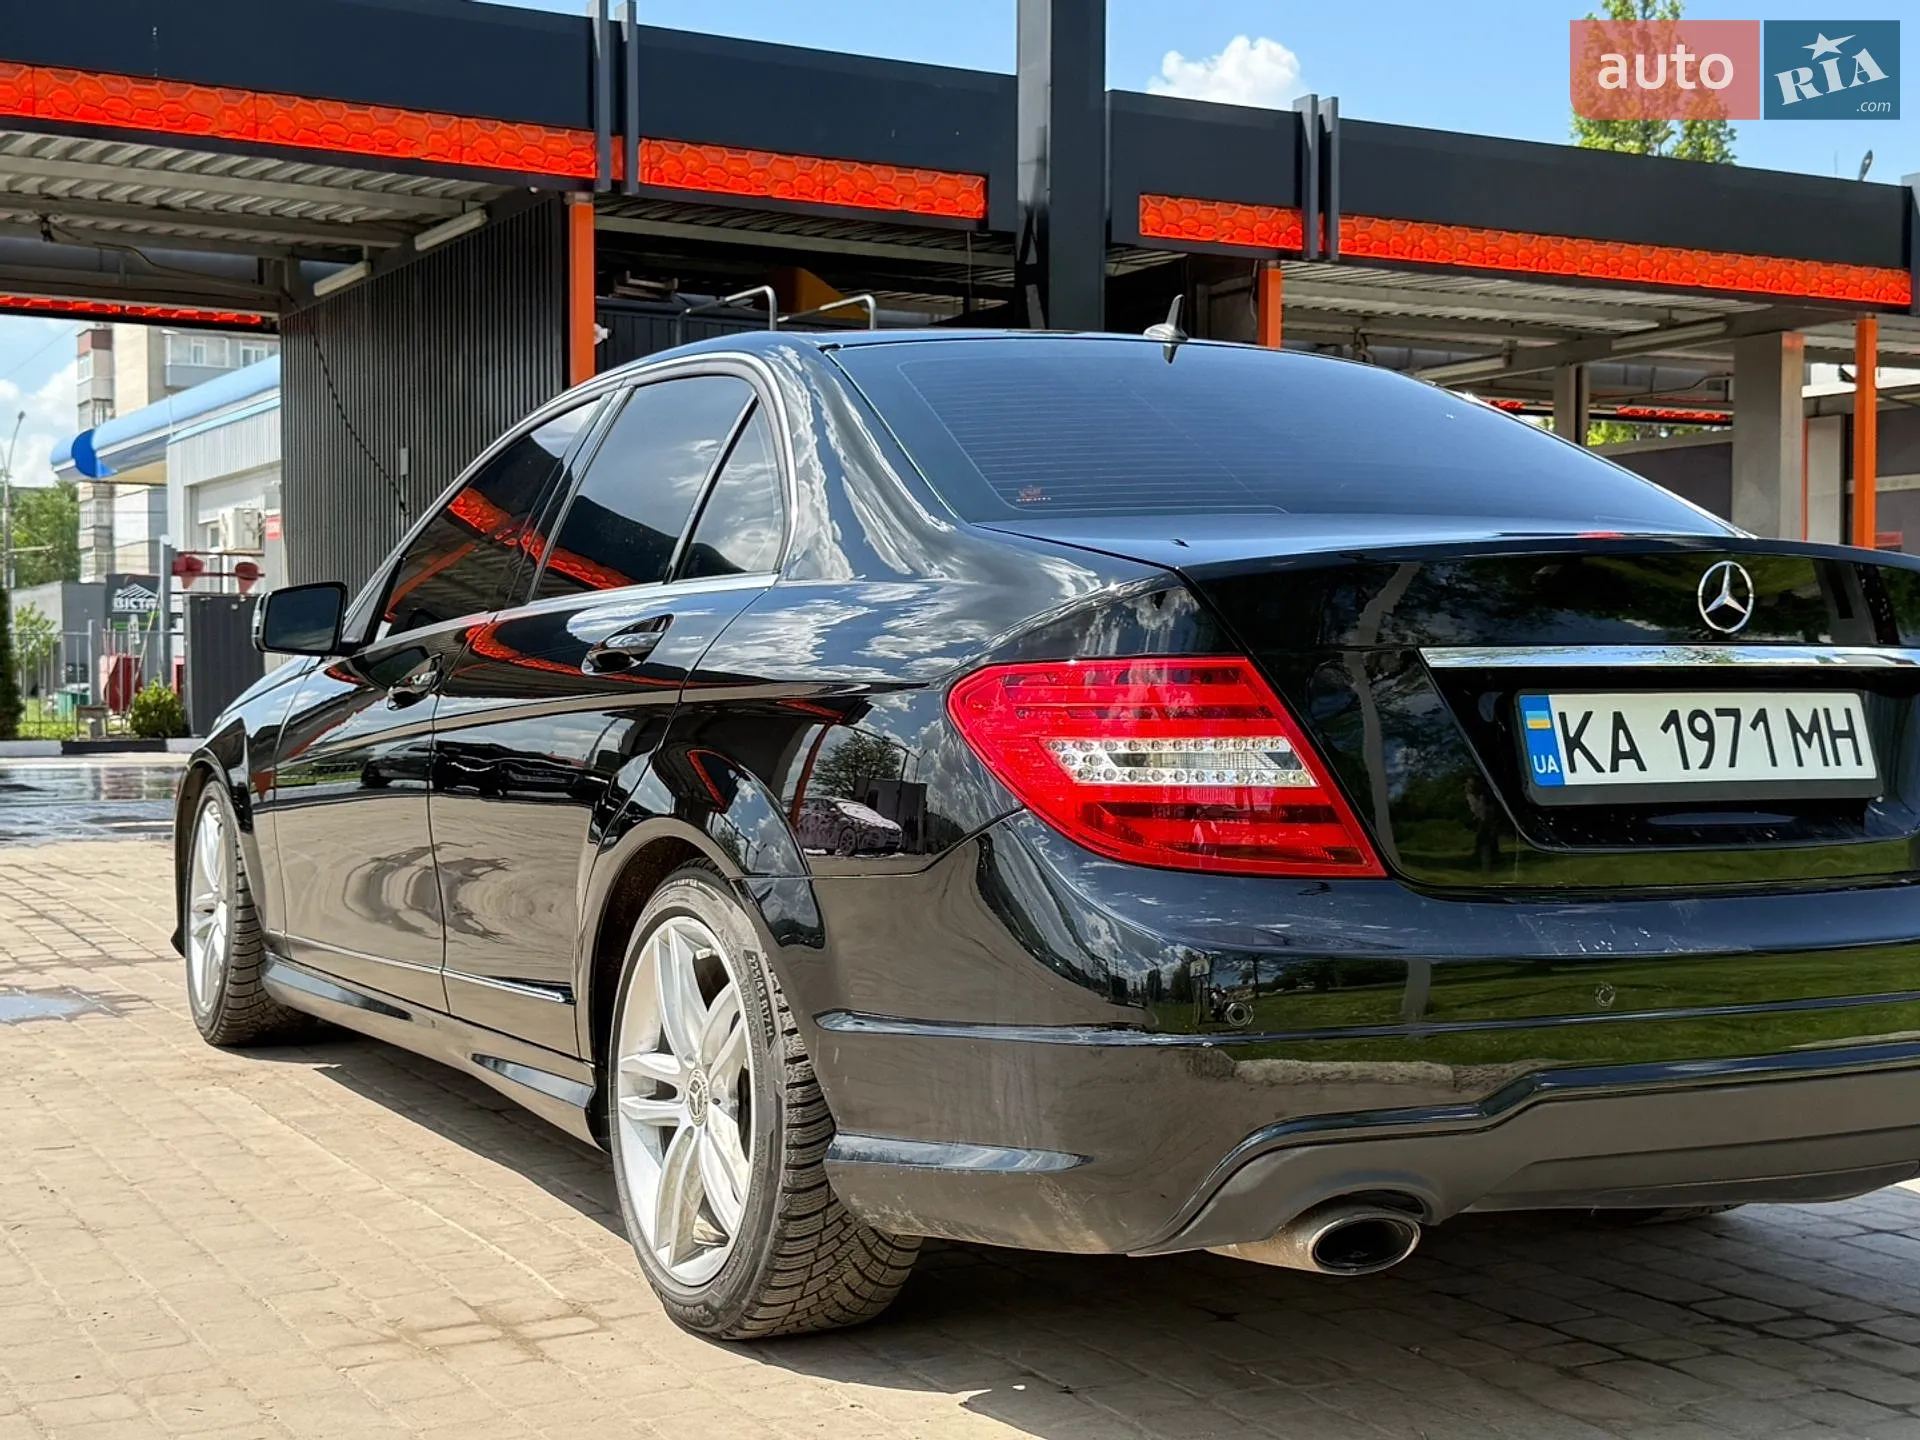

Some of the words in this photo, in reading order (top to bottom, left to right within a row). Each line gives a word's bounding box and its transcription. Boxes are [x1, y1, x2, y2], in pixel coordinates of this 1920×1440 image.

[1558, 711, 1648, 773] KA
[1660, 708, 1778, 771] 1971
[1785, 707, 1863, 768] MH
[1534, 755, 1560, 775] UA
